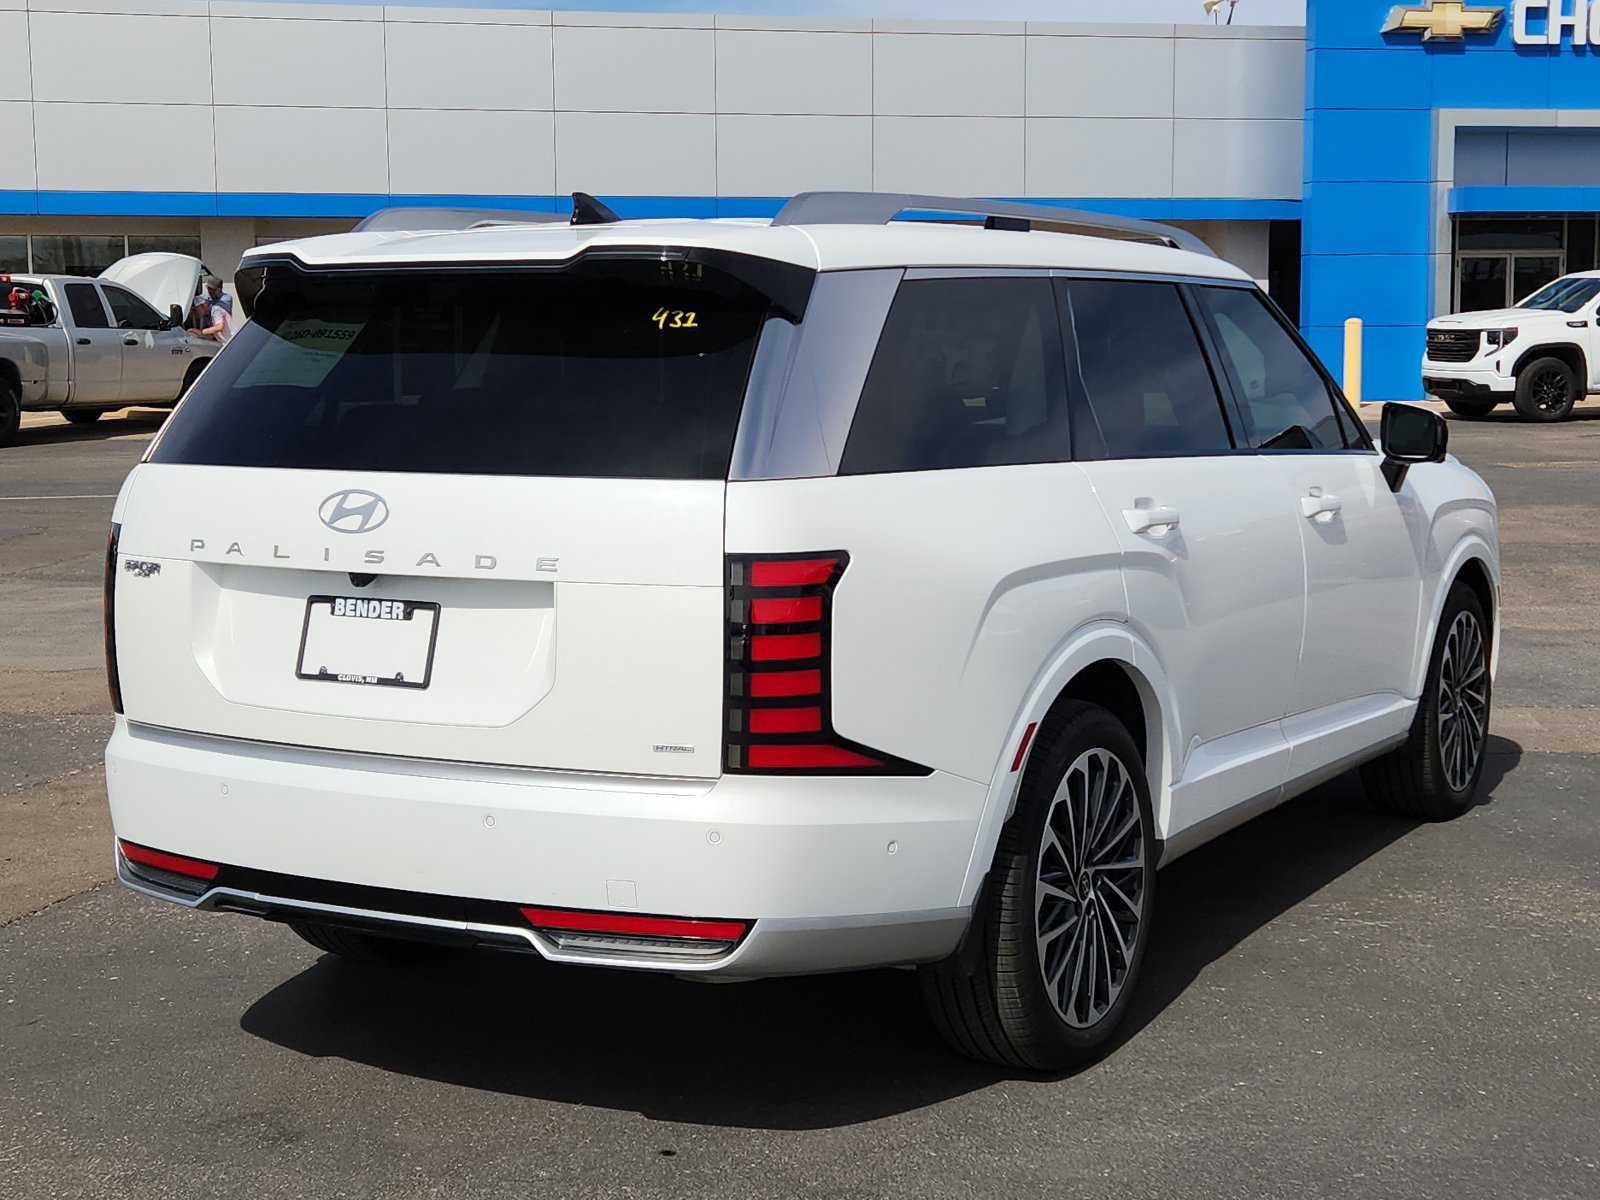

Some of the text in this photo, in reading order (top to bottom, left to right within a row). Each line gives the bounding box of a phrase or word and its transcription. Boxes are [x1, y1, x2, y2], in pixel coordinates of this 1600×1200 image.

[190, 539, 559, 573] PALISADE
[334, 598, 405, 620] BENDER
[337, 673, 365, 684] CLOVIS,
